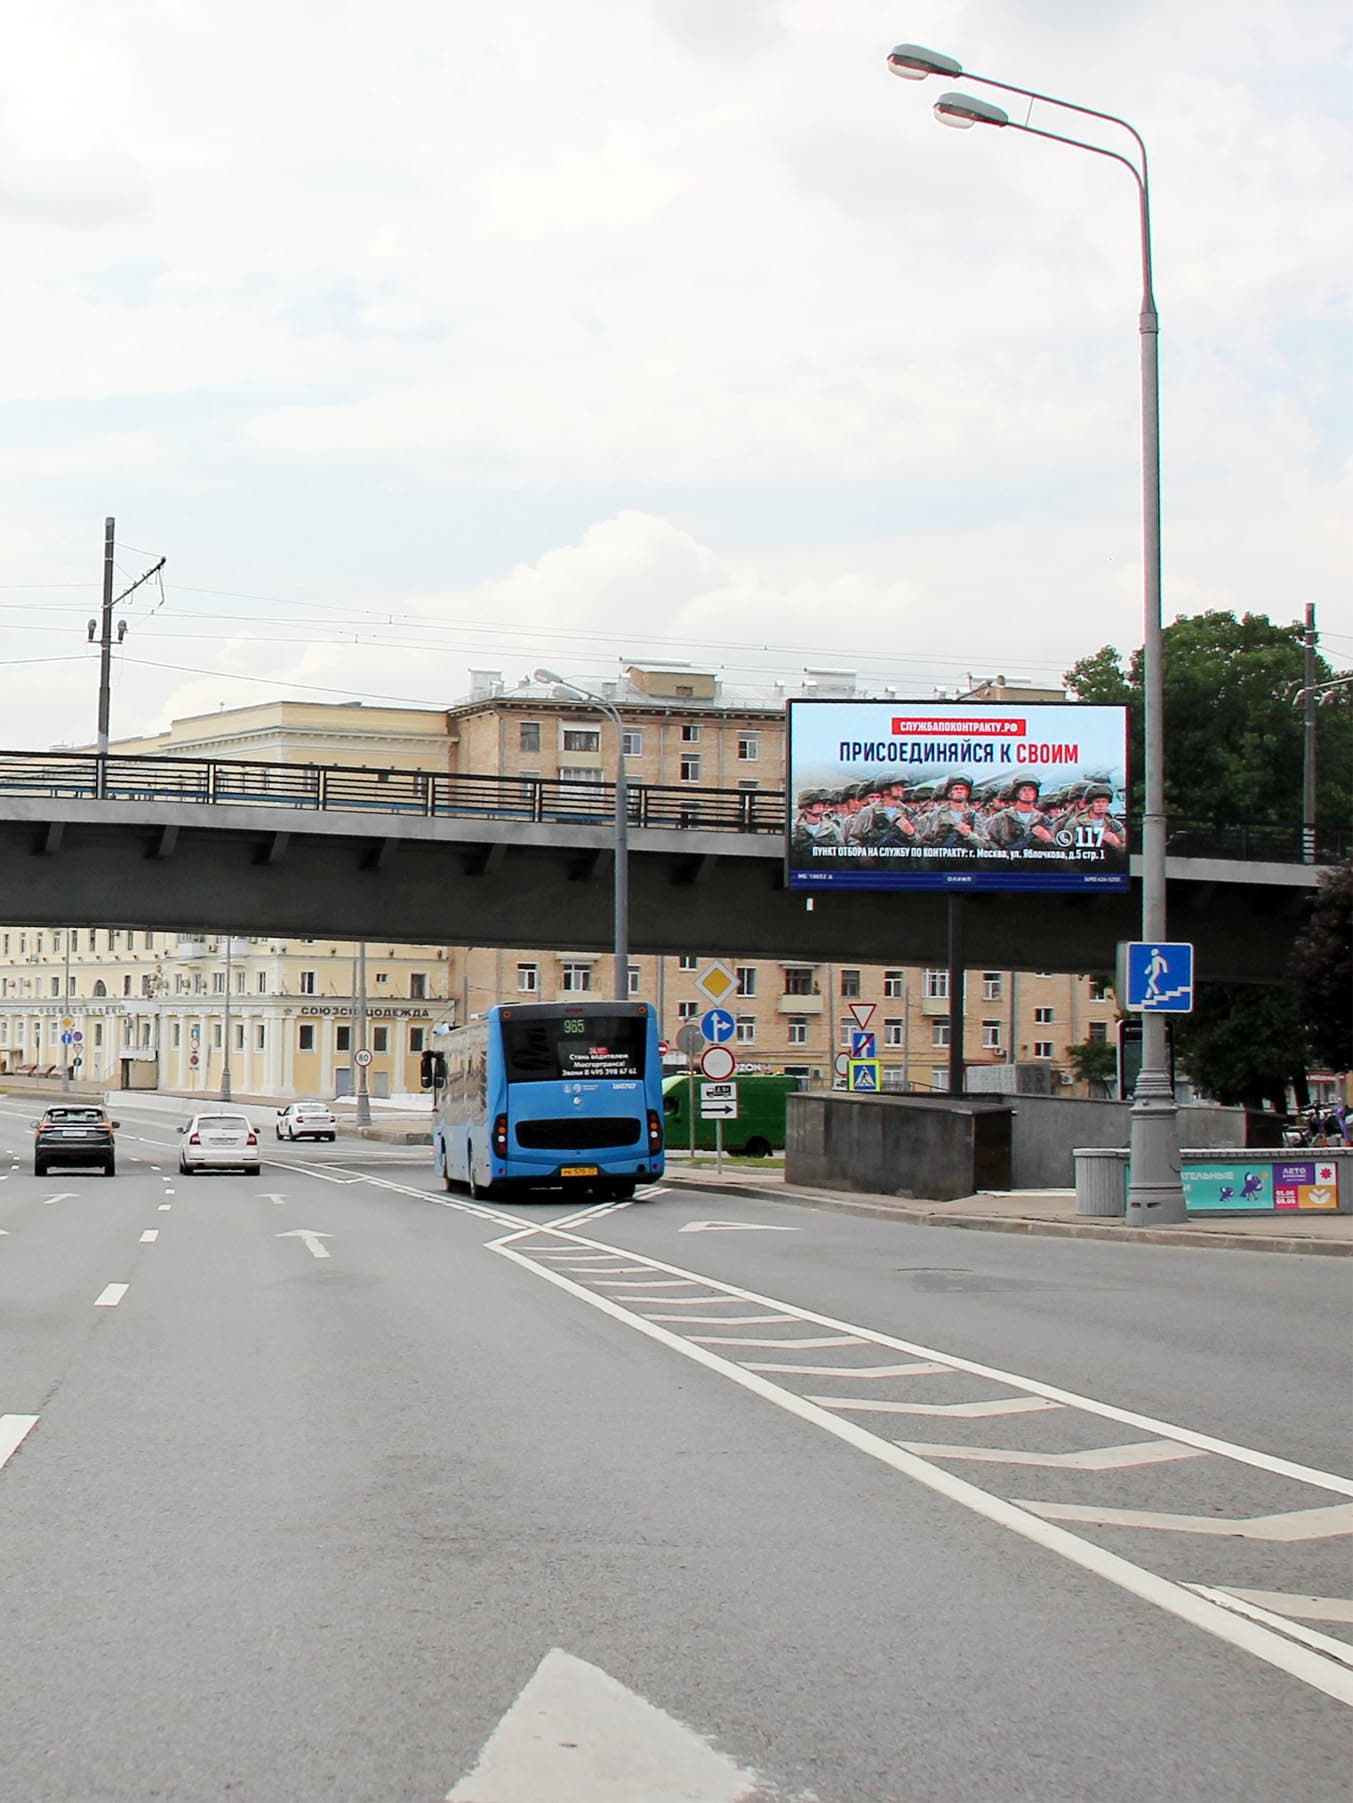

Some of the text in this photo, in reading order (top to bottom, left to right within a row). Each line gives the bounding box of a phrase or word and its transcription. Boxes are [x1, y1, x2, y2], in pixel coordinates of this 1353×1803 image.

[900, 720, 1019, 733] СЛУЖБАПОКОНТРАКТУ.РФ
[839, 738, 1079, 764] ПРИСОЕДИНЯЙСЯ К СВОИМ
[1075, 827, 1105, 848] 117
[812, 846, 837, 857] ПУНКТ
[837, 846, 867, 857] ОТБОРА
[867, 847, 879, 857] НА
[879, 847, 910, 857] СЛУЖБУ
[911, 847, 922, 857] ПО
[301, 1006, 430, 1018] СОЮЗСПЦОДЕЖДА
[564, 1019, 585, 1033] 965
